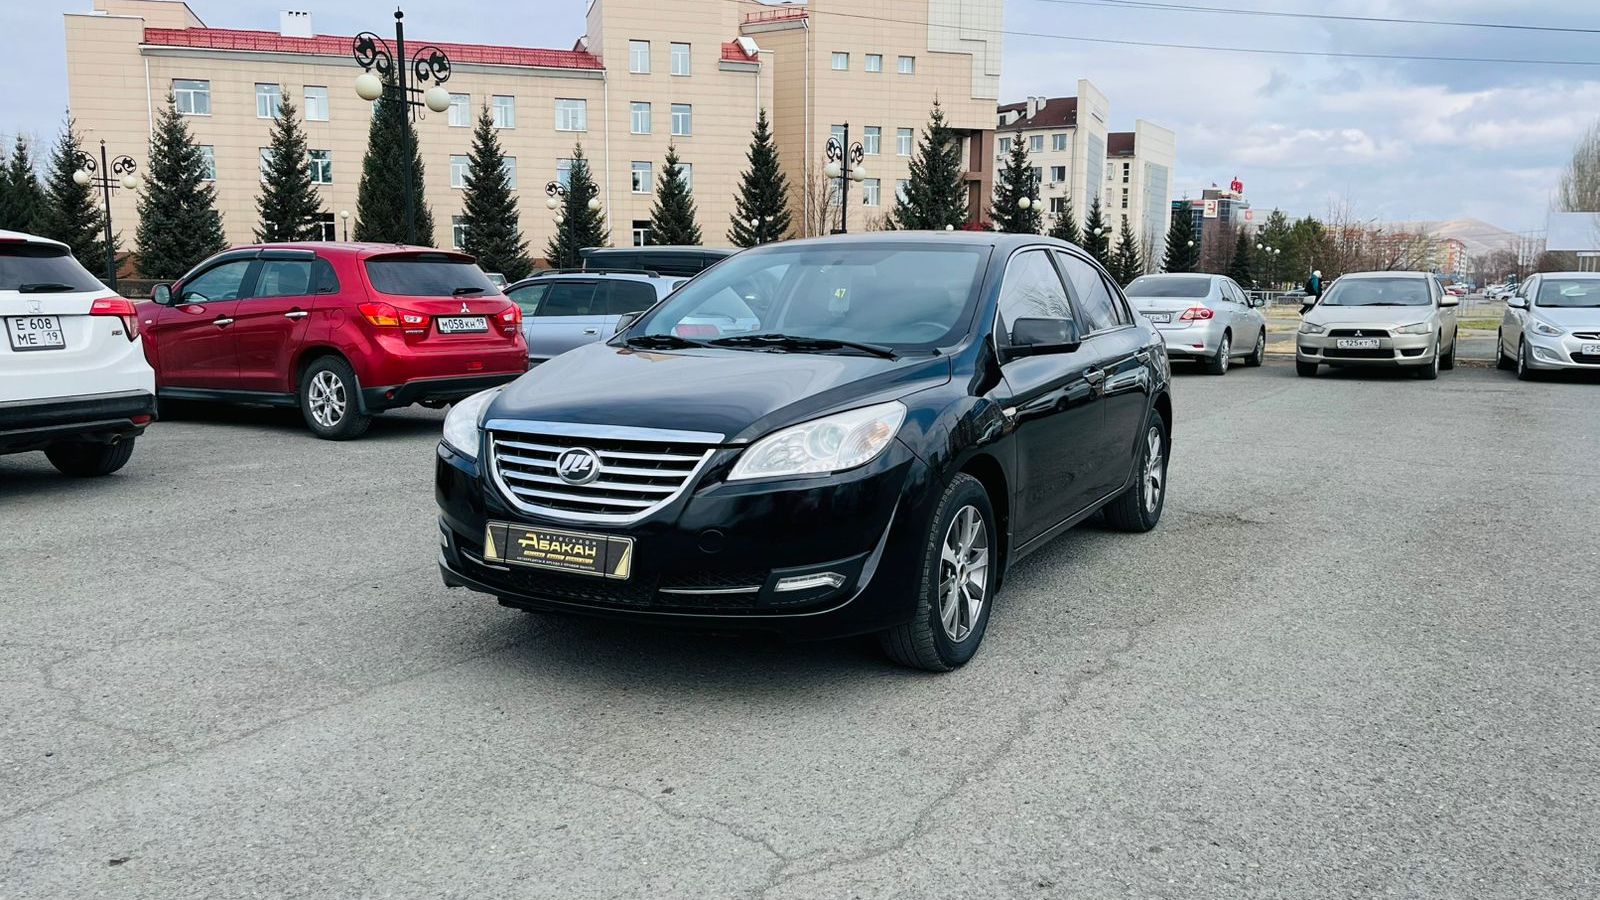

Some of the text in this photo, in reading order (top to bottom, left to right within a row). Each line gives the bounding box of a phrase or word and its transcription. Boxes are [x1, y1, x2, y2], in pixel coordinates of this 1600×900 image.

[834, 288, 846, 298] 47
[46, 331, 58, 341] 19
[540, 534, 597, 545] АВТОСАЛОН
